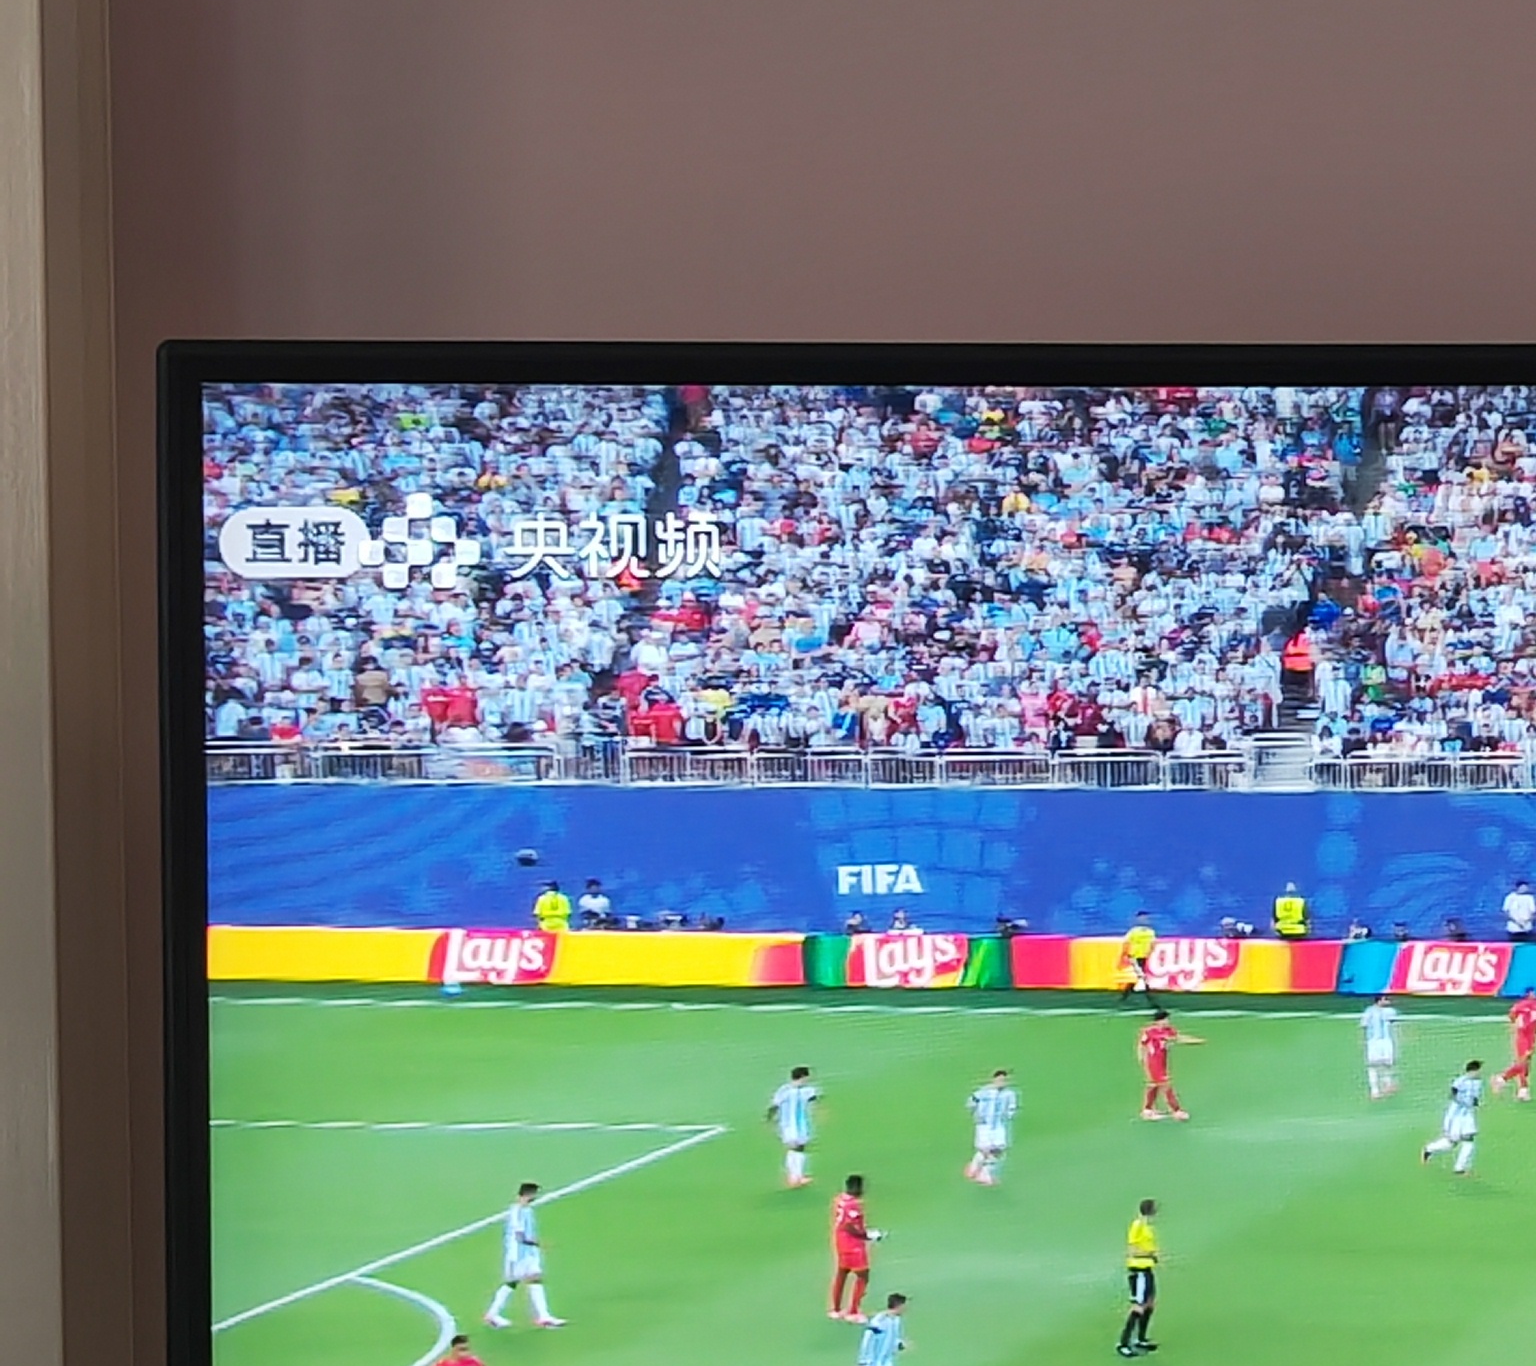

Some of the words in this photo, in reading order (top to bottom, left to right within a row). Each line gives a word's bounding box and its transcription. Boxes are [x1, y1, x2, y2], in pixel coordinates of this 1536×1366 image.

[244, 519, 346, 565] 直播
[503, 512, 722, 579] 央视频
[837, 864, 924, 894] FIFA
[443, 928, 545, 984] Lay's
[864, 934, 960, 987] Lays
[1406, 944, 1498, 993] Lay's
